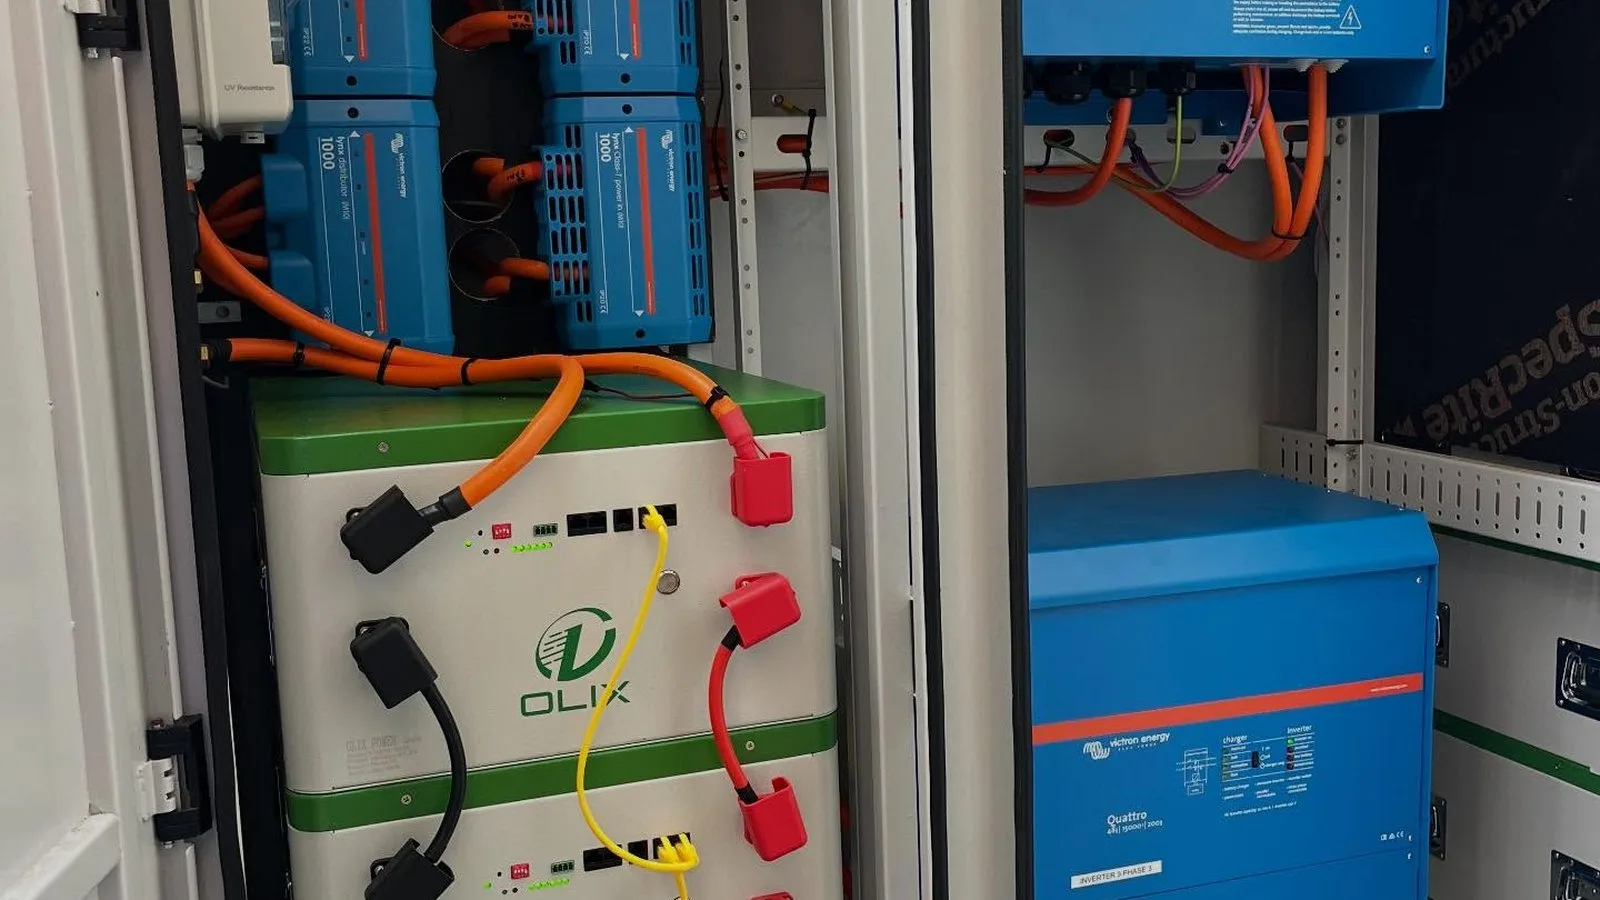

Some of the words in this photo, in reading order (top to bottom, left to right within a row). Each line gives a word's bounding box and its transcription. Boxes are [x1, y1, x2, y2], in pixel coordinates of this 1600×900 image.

[336, 136, 345, 156] lynx
[599, 132, 611, 162] 1000
[611, 132, 621, 150] lynx
[321, 136, 335, 170] 1000
[398, 153, 406, 175] victron
[339, 157, 348, 197] distributor
[399, 175, 407, 198] energy
[613, 179, 622, 202] power
[520, 680, 631, 717] OLIX
[1109, 735, 1139, 748] victron
[1140, 732, 1170, 743] energy
[1222, 735, 1248, 744] charger
[1106, 811, 1147, 826] Quattro
[1079, 871, 1115, 885] INVERTER
[1122, 866, 1146, 877] PHASE
